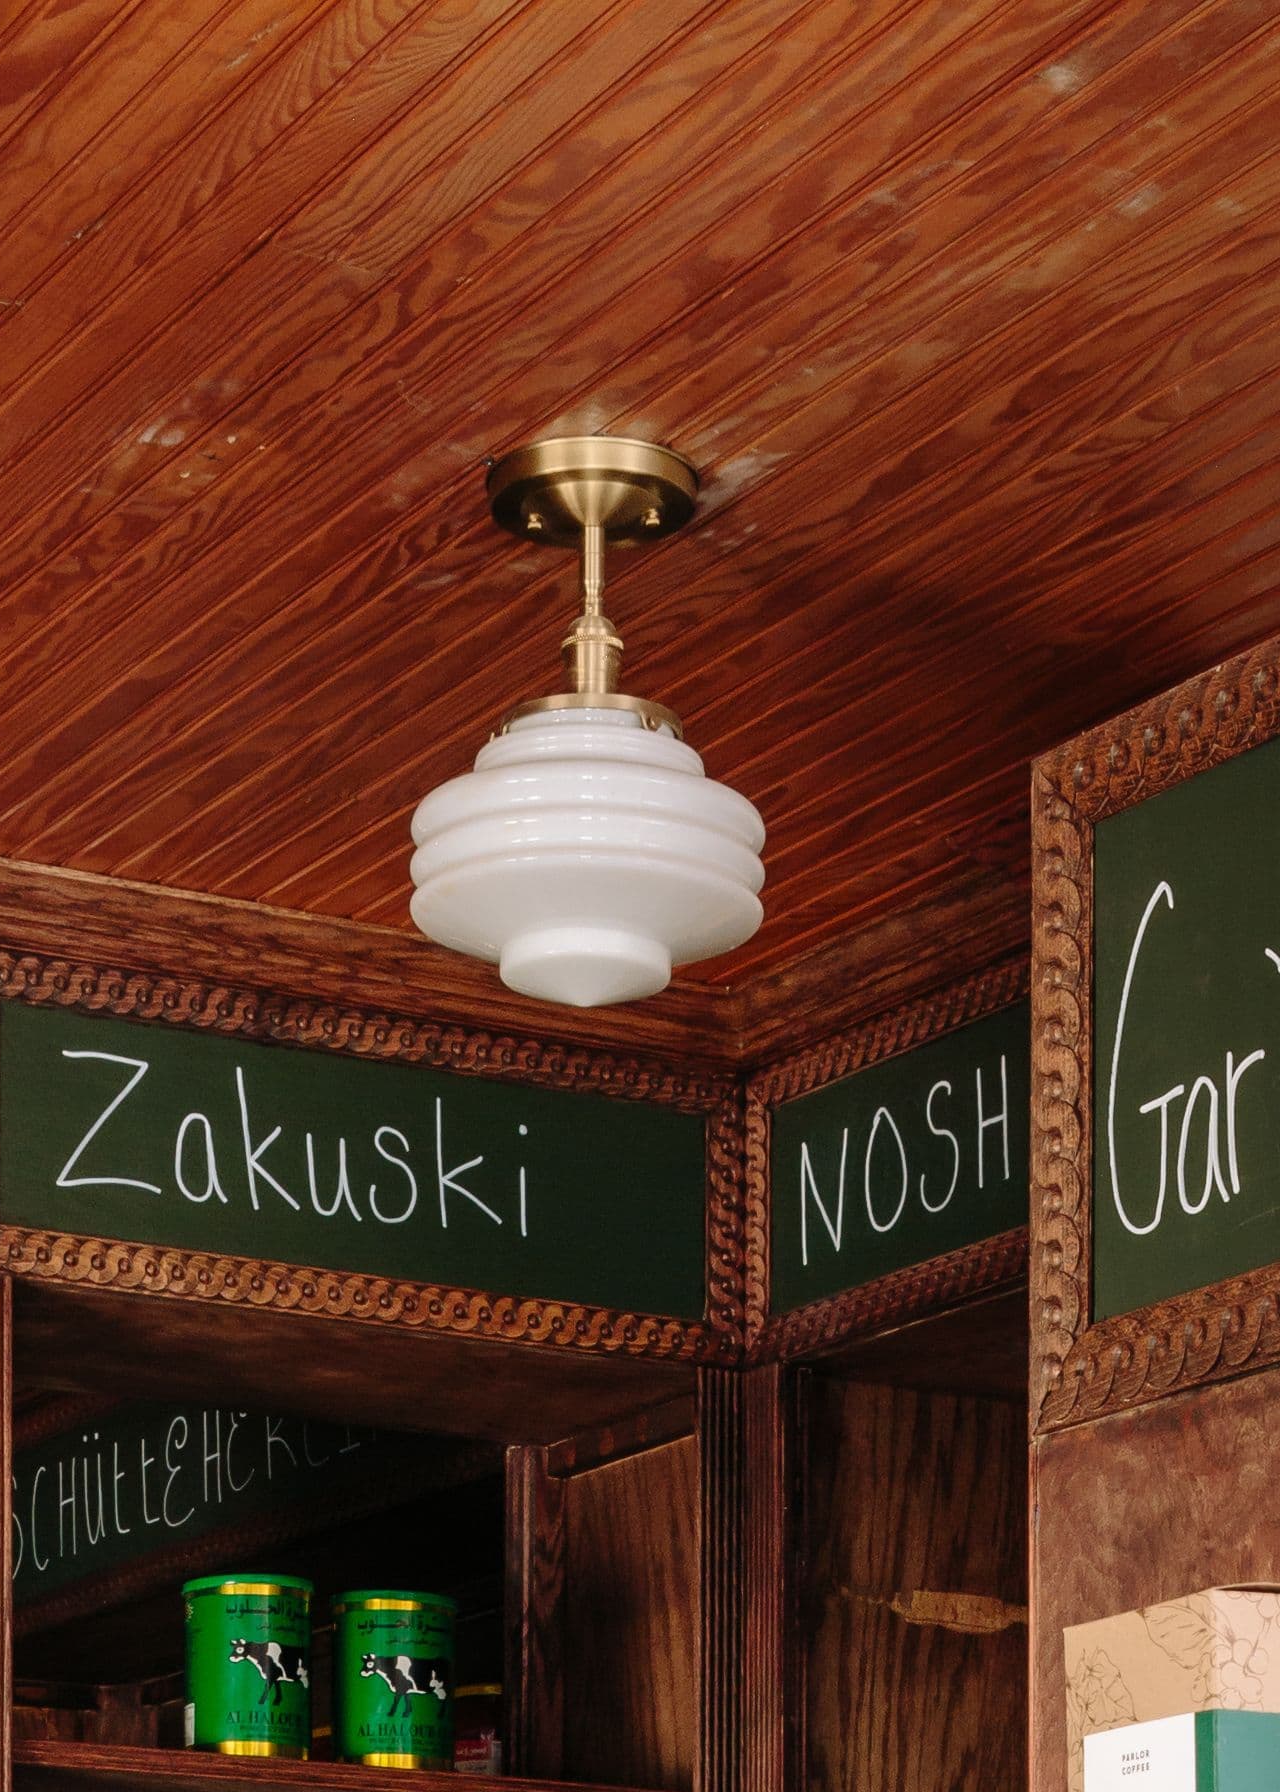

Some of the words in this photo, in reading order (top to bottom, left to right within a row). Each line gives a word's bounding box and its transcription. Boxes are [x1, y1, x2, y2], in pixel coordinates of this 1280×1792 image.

[57, 1050, 528, 1237] Zakuski
[799, 1054, 1012, 1268] NOSH
[1121, 1749, 1151, 1763] PARLOR
[1121, 1762, 1151, 1776] COFFEE
